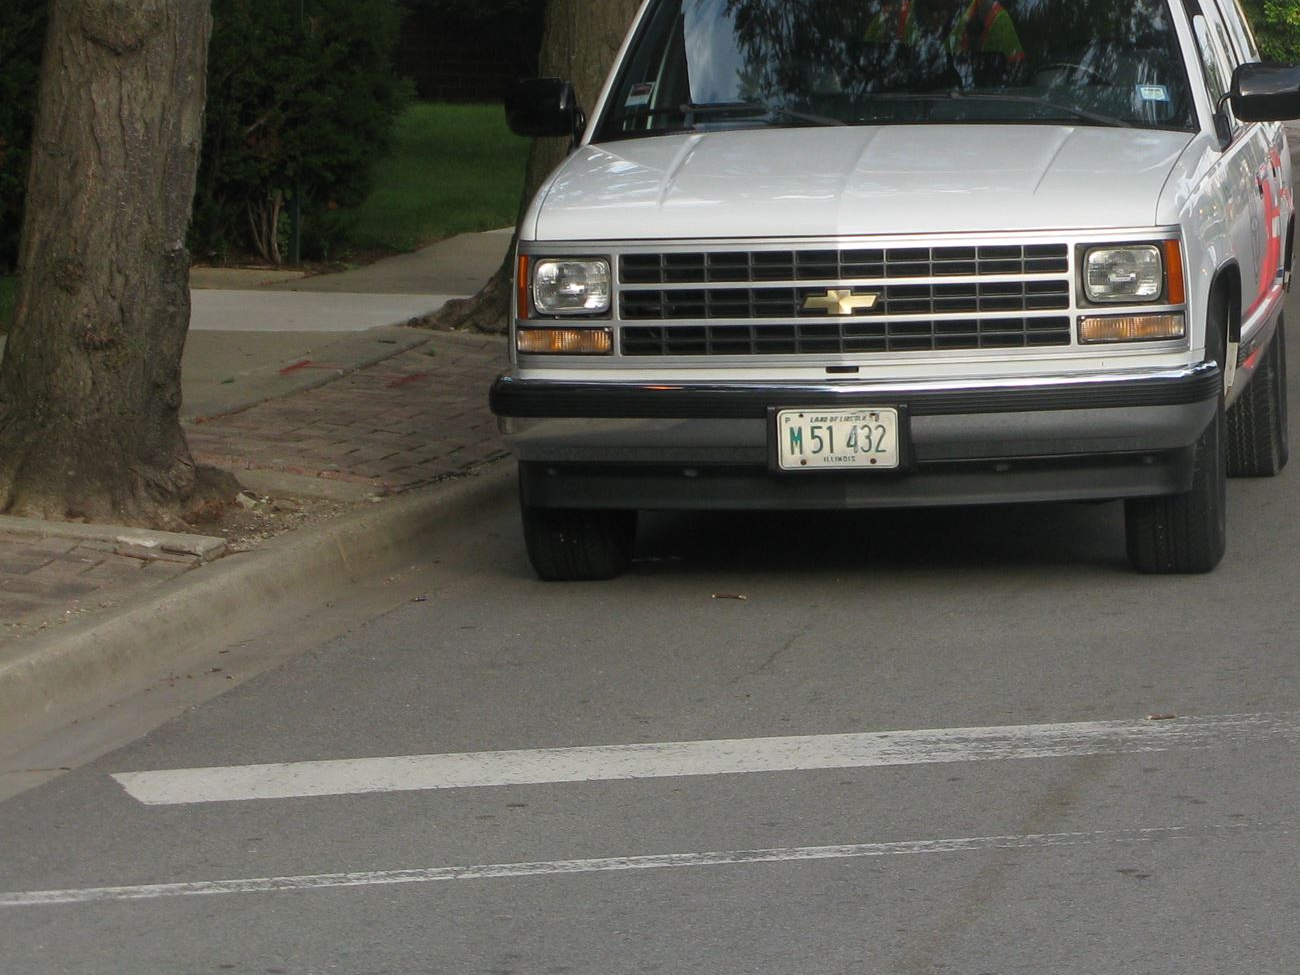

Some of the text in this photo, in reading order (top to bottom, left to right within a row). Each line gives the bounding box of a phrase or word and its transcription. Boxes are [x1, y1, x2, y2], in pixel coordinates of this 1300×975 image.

[789, 424, 887, 455] M 51 432
[823, 455, 857, 463] ILLINOIS
